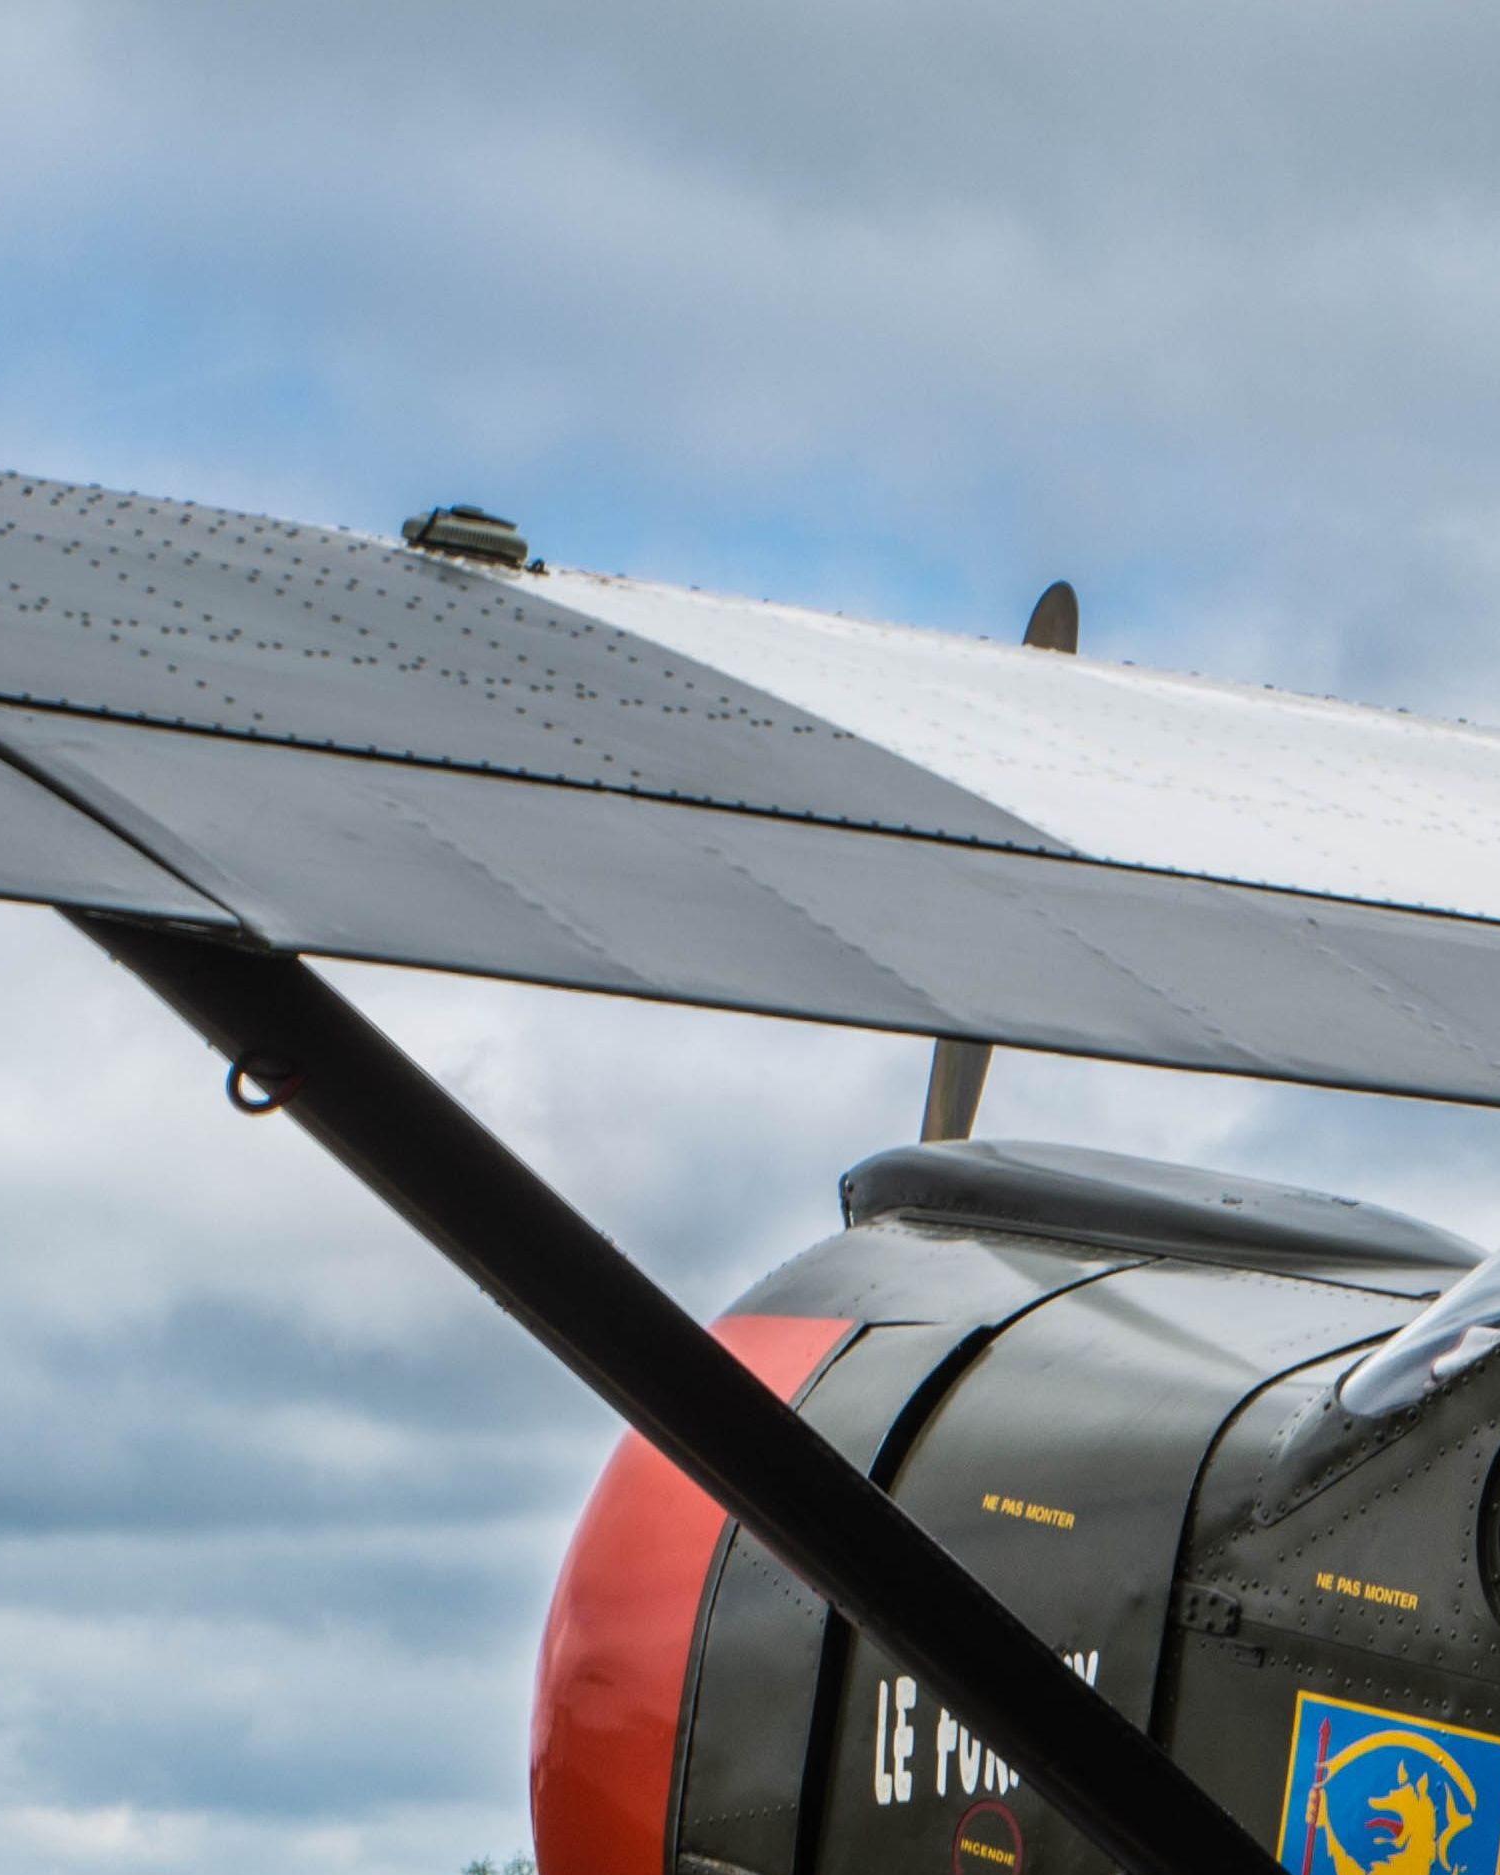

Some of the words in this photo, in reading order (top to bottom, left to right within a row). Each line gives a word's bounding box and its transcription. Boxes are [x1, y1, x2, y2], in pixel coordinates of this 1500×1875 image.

[982, 1493, 1000, 1512] NE
[1001, 1498, 1024, 1518] PAS
[1025, 1503, 1076, 1530] MONTER
[1316, 1572, 1334, 1591] NE
[1336, 1576, 1361, 1598] PAS
[1364, 1583, 1419, 1611] MONTER
[874, 1675, 917, 1806] LE
[960, 1836, 1016, 1868] INCENDIE
